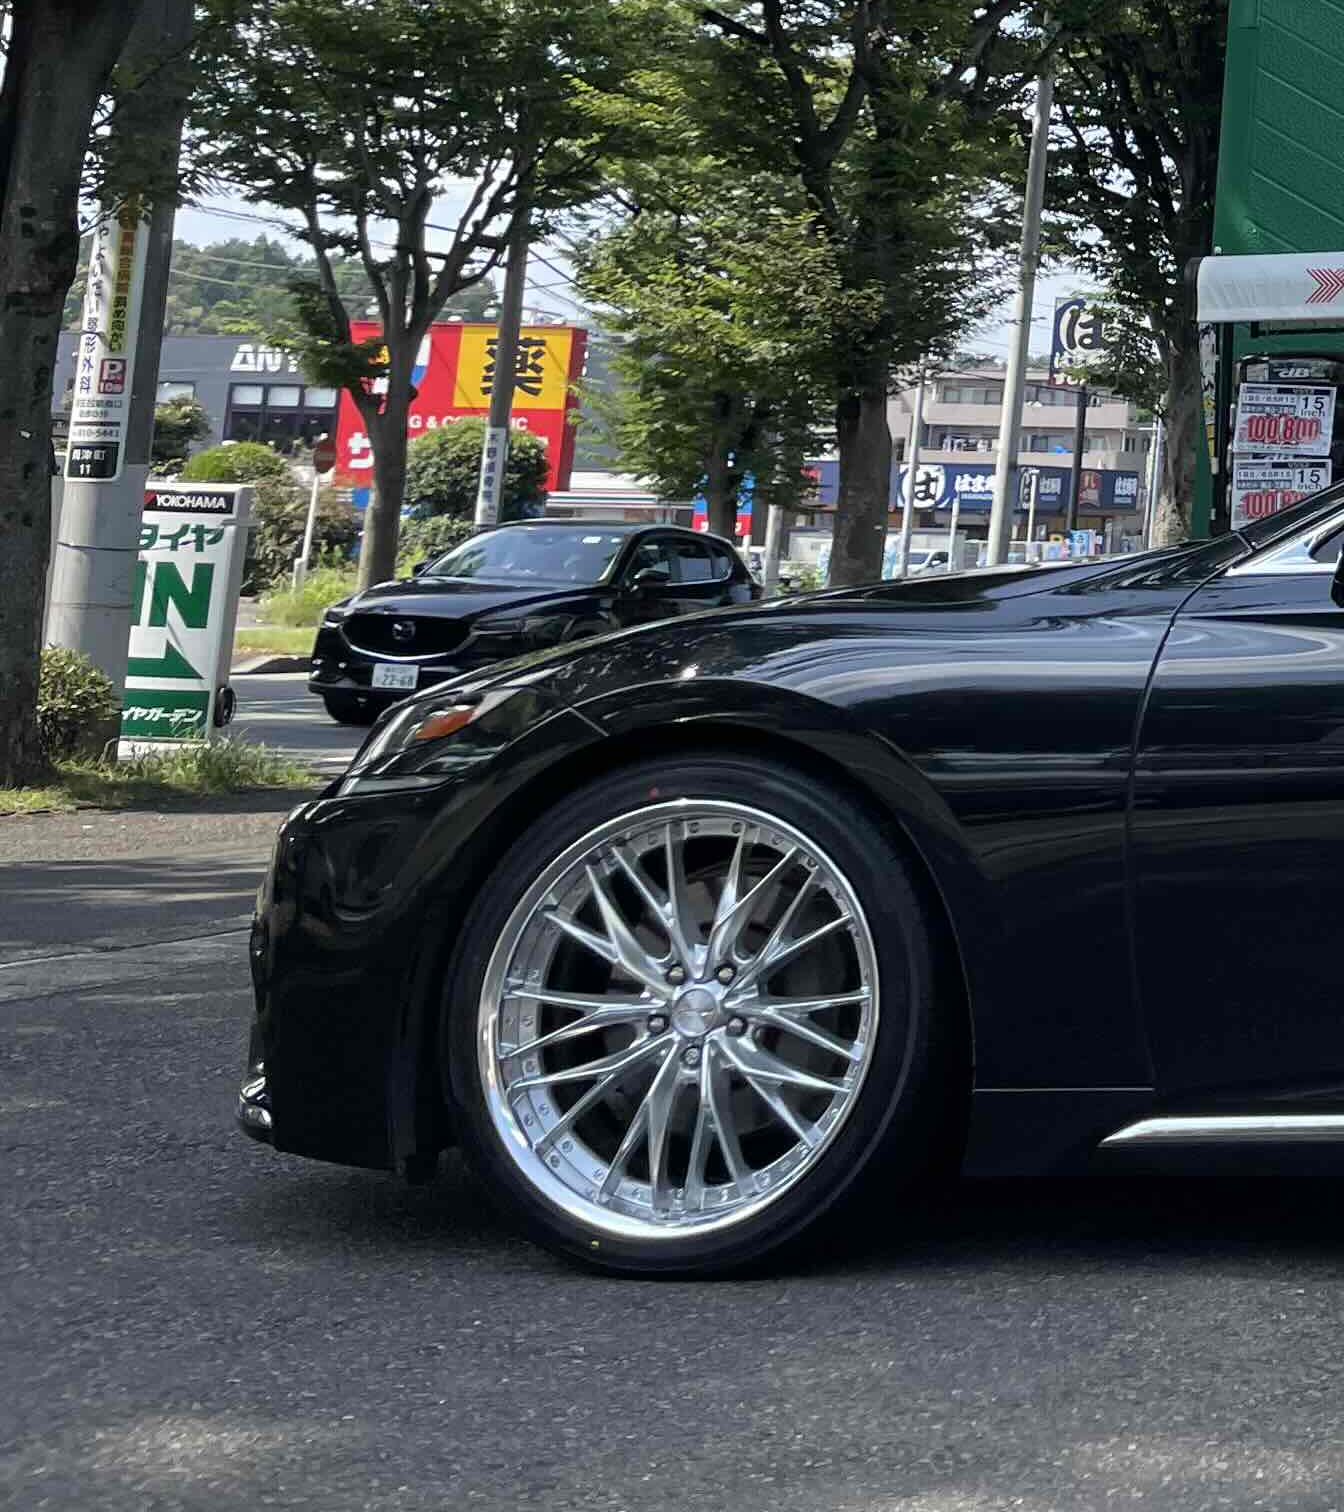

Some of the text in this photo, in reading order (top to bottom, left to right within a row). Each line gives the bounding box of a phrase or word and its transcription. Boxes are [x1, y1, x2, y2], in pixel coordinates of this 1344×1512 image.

[1302, 396, 1325, 410] 15
[79, 463, 91, 475] 11
[1298, 469, 1321, 484] 15
[156, 494, 226, 509] YOKOHAMA
